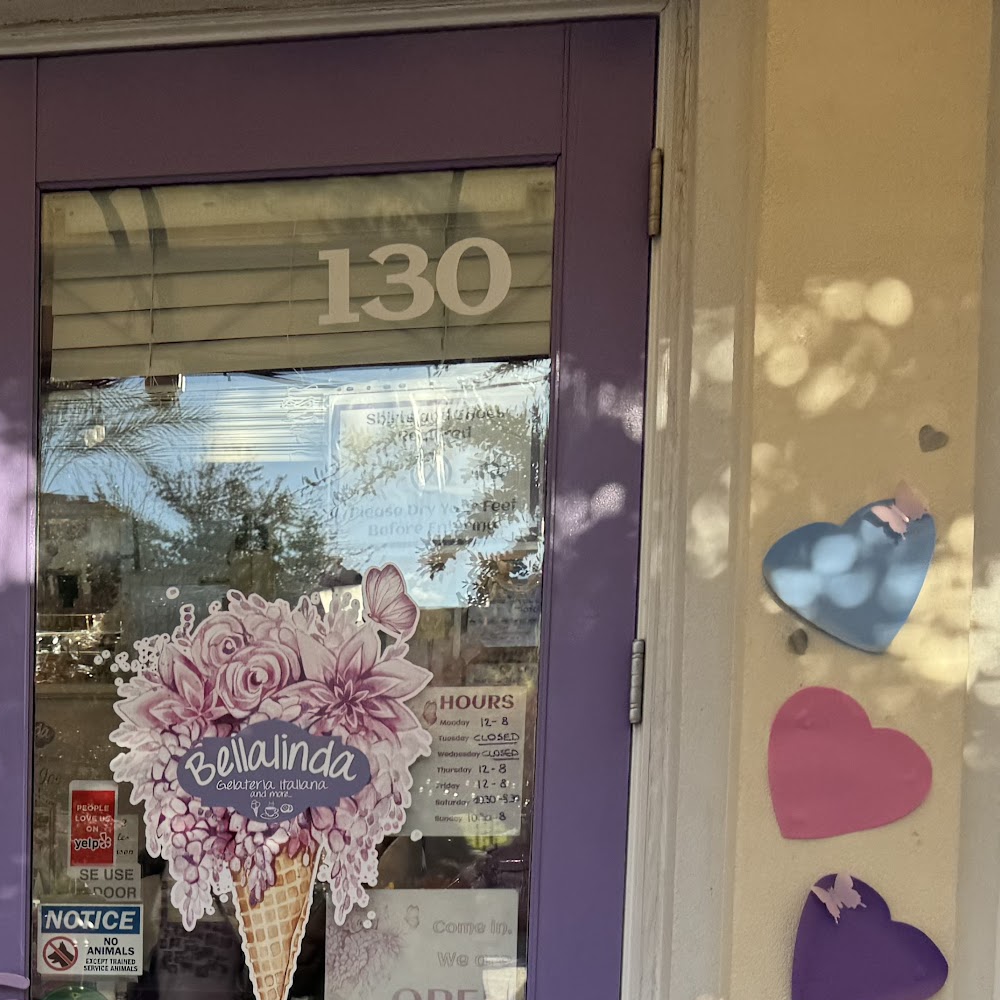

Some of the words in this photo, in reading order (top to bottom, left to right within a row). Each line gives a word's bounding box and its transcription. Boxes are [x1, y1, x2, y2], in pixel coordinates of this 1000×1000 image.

[317, 236, 513, 326] 130
[440, 694, 514, 710] HOURS
[440, 719, 470, 728] Monday
[473, 732, 520, 742] CLOSED
[437, 750, 480, 758] Wednesday
[481, 748, 520, 758] CLOSED
[184, 733, 358, 786] Bellalinda
[437, 766, 472, 775] Thursday
[216, 778, 276, 791] Gelateria
[435, 781, 460, 790] Friday
[249, 790, 267, 798] and
[76, 804, 110, 812] PEOPLE
[435, 799, 470, 807] Saturday
[86, 825, 99, 833] ON
[74, 837, 100, 851] yelp
[104, 868, 134, 881] USE
[45, 910, 136, 931] NOTICE
[432, 919, 486, 935] Come
[103, 937, 119, 946] NO
[86, 946, 135, 956] ANIMALS
[85, 957, 108, 965] EXCEPT
[437, 951, 469, 967] We
